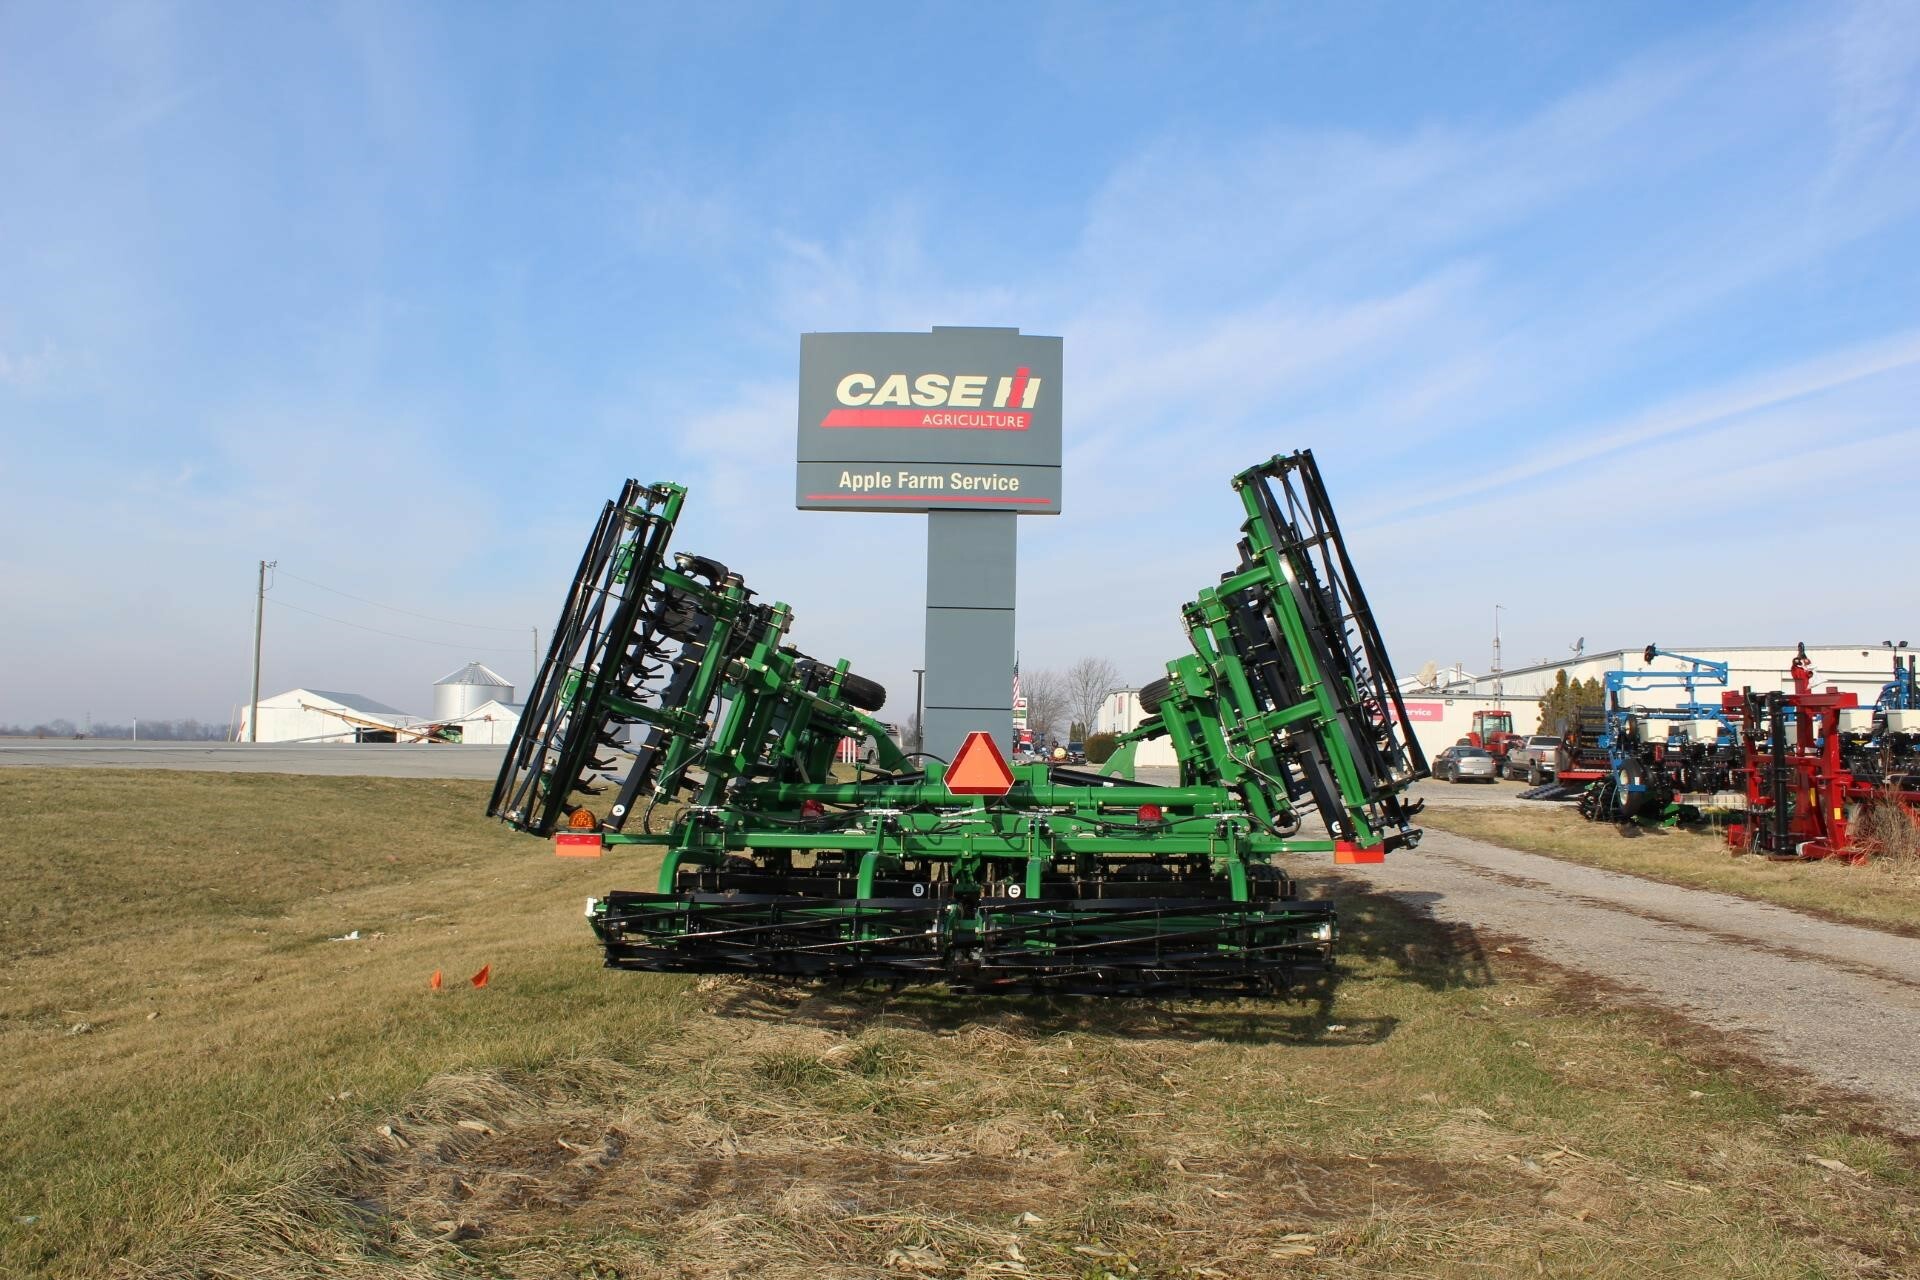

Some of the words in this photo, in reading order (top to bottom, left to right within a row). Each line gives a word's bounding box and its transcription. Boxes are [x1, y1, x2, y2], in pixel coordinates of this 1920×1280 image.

[836, 373, 988, 407] CASE
[922, 413, 1025, 428] AGRICULTURE
[839, 471, 891, 492] Apple
[898, 471, 944, 489] Farm
[950, 472, 1020, 491] Service
